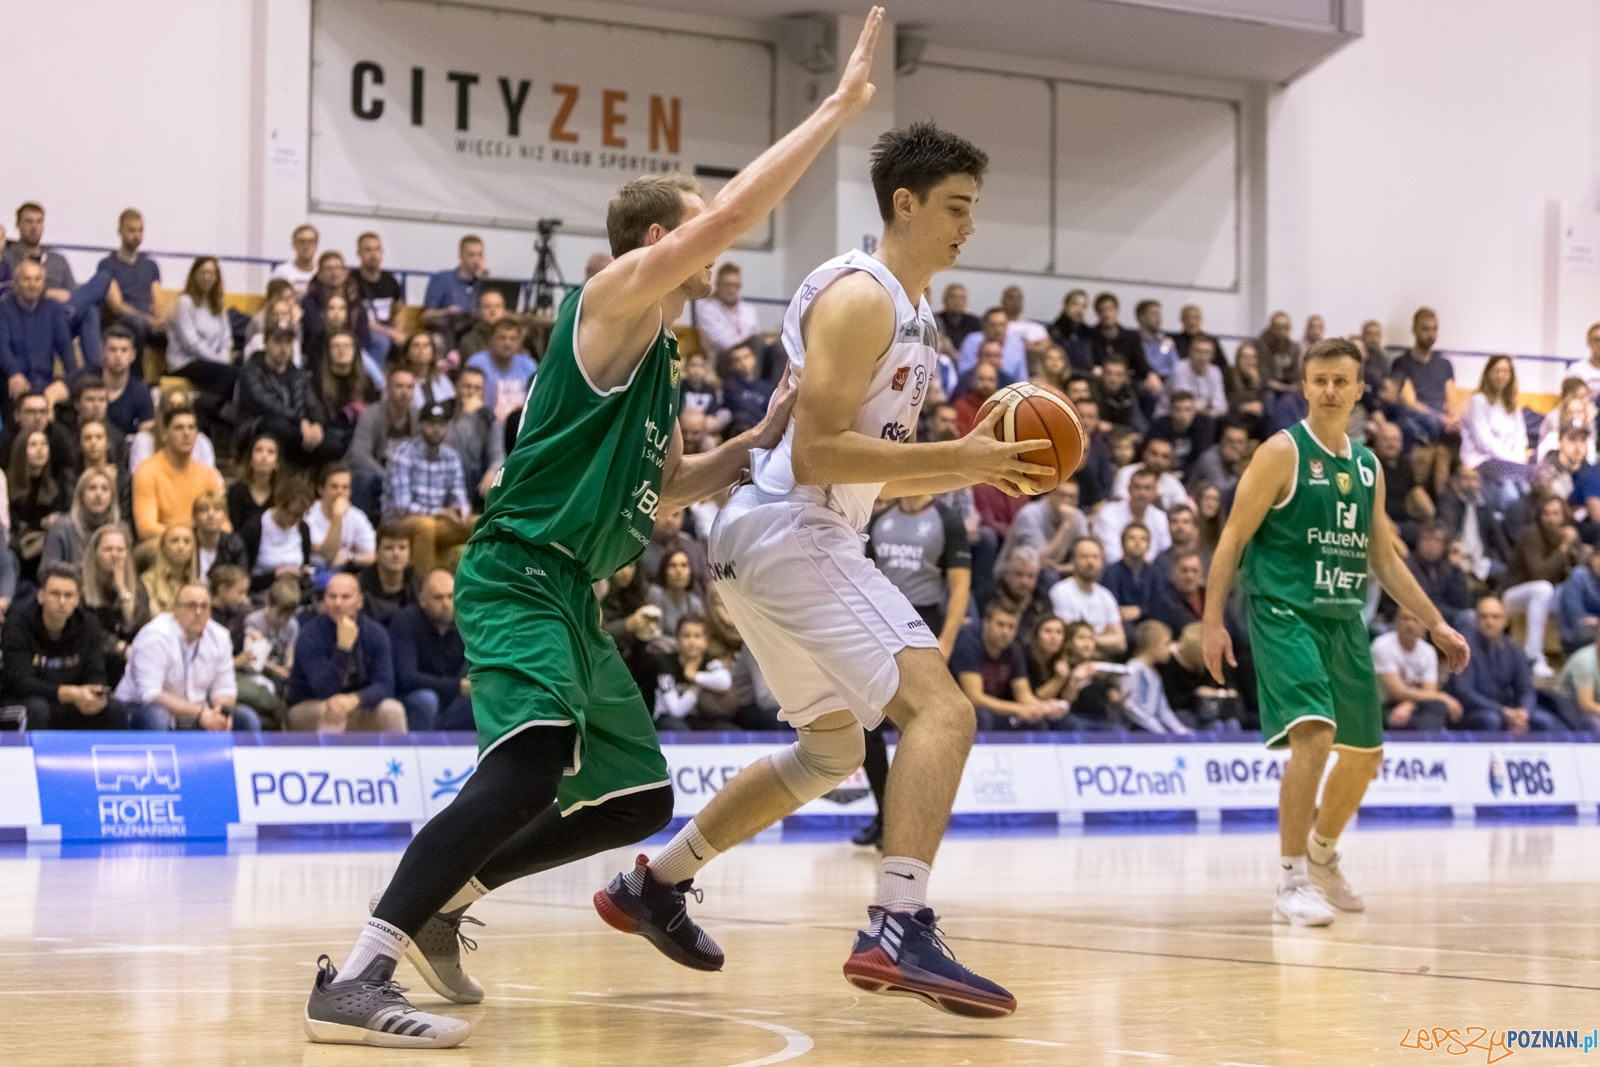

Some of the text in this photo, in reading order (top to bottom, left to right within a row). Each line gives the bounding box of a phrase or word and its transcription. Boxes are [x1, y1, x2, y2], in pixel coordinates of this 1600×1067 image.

[351, 60, 682, 154] CITYZEN
[551, 149, 593, 166] KLUB
[599, 152, 682, 173] SPORTOWY
[1206, 760, 1287, 784] BIOFA
[1382, 758, 1448, 783] FARM
[1506, 760, 1555, 795] PBG
[98, 795, 185, 824] HOTEL
